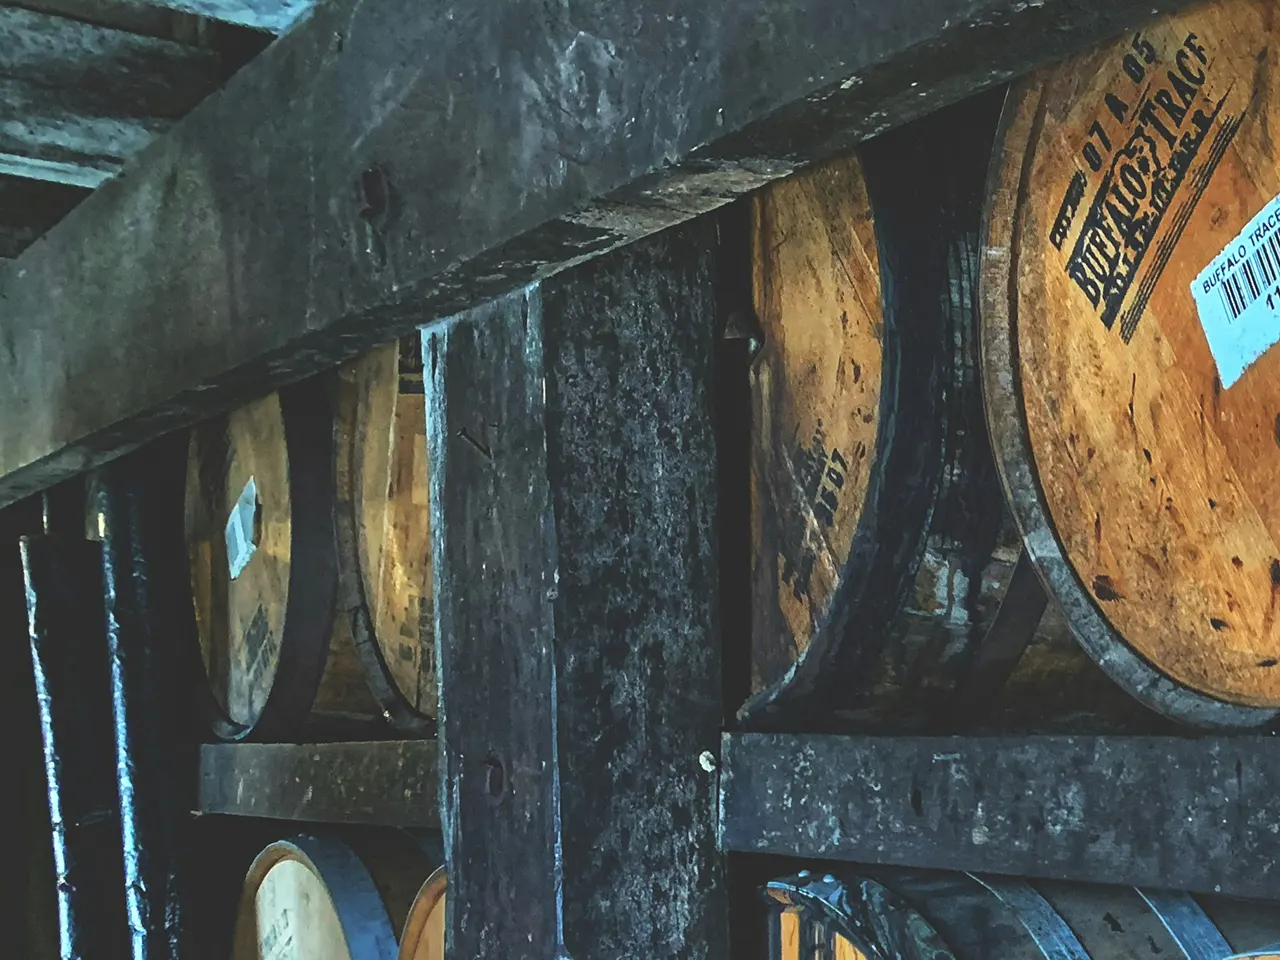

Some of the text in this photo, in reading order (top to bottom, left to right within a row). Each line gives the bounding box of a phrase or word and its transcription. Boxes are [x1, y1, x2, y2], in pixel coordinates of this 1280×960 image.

[1082, 120, 1112, 172] 07
[1104, 92, 1129, 124] A
[1202, 244, 1247, 294] BUFFALO
